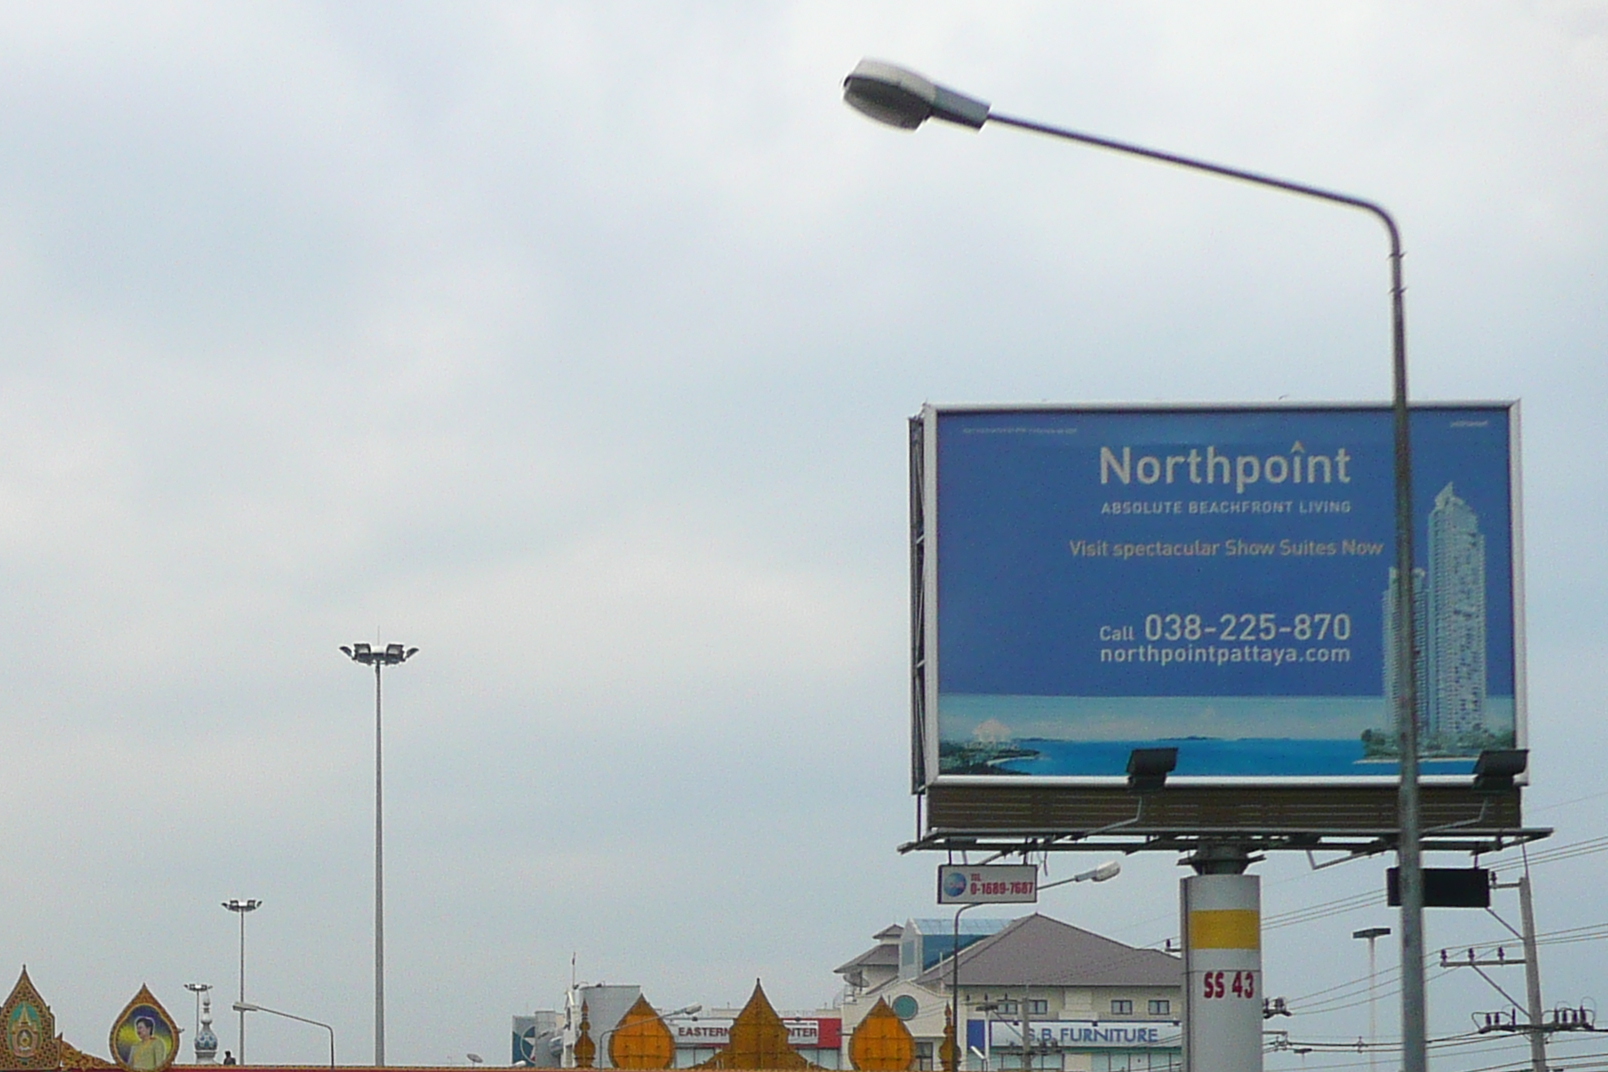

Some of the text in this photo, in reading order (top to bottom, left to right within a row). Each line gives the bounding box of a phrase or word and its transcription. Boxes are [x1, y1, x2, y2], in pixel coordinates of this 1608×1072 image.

[1100, 440, 1351, 494] Northpoint
[1101, 500, 1351, 514] ABSOLUTE BEACHFRONT LIVING
[1069, 538, 1384, 560] Visit spectacular Show Suites Now
[1099, 613, 1351, 642] Call 038-225-870
[1100, 645, 1351, 667] northpointpattaya.com
[1204, 971, 1254, 999] SS 43
[678, 1027, 730, 1037] EASTERN
[1059, 1028, 1158, 1042] FURNITURE
